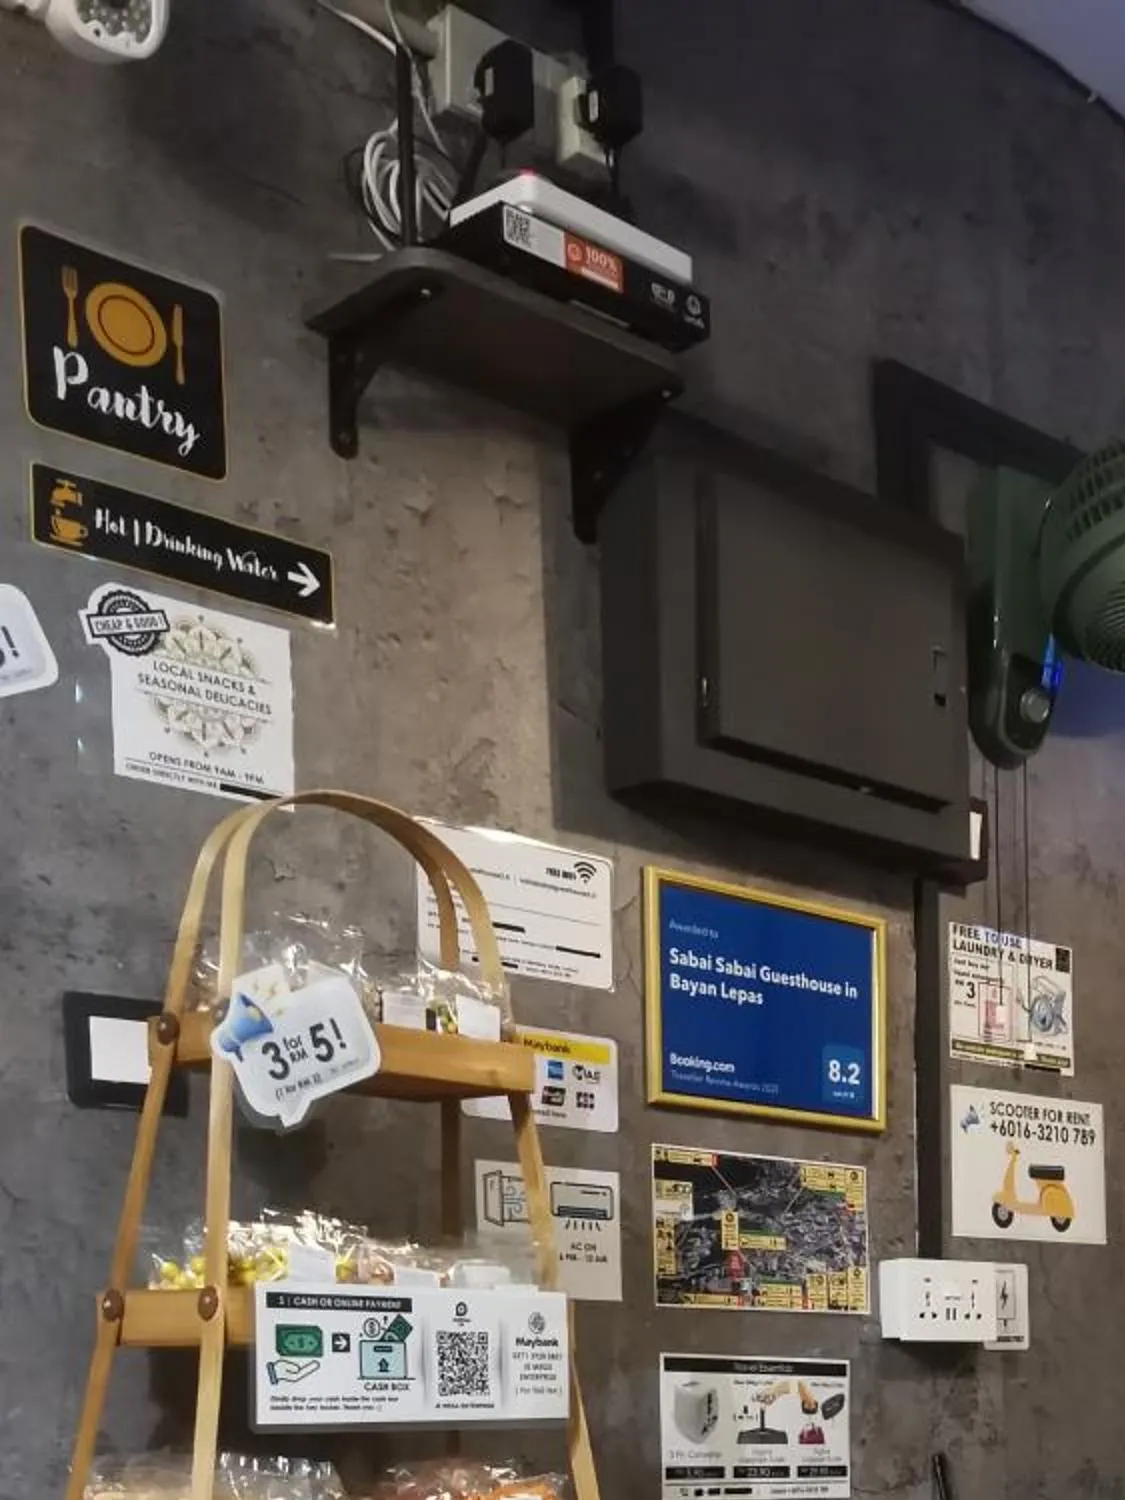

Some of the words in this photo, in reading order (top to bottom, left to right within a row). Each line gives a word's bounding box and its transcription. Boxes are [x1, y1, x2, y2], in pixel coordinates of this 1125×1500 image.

[53, 346, 199, 457] Pantry
[95, 508, 126, 536] Hot
[145, 521, 223, 571] Drinking
[227, 548, 278, 579] Water
[153, 661, 193, 680] LOCAL
[197, 671, 245, 693] SNACKS
[138, 672, 200, 698] SEASONAL
[205, 689, 272, 715] DELICACIES
[149, 751, 181, 766] OPENS
[184, 758, 212, 773] FROM
[953, 924, 981, 940] FREE
[1000, 935, 1022, 948] USE
[953, 940, 1004, 960] LAUNDRY
[669, 947, 712, 971] Sabai
[715, 956, 756, 980] Sabai
[759, 965, 841, 995] Guesthouse
[845, 981, 857, 1000] in
[669, 972, 717, 997] Bayan
[721, 981, 763, 1006] Lepas
[966, 981, 976, 999] 3
[261, 1041, 290, 1080] 3
[309, 1018, 347, 1063] 5!
[669, 1052, 735, 1073] Booking.com
[828, 1058, 861, 1085] 8.2
[990, 1101, 1039, 1120] SCOOTER
[1042, 1107, 1063, 1122] FOR
[990, 1119, 1069, 1143] +6016-3210
[293, 1296, 318, 1307] CASH
[320, 1297, 332, 1307] OR
[334, 1298, 363, 1308] ONLINE
[365, 1299, 402, 1310] PAYMENT
[516, 1337, 558, 1349] Maybank
[363, 1382, 388, 1392] CASH
[391, 1382, 410, 1392] BOX
